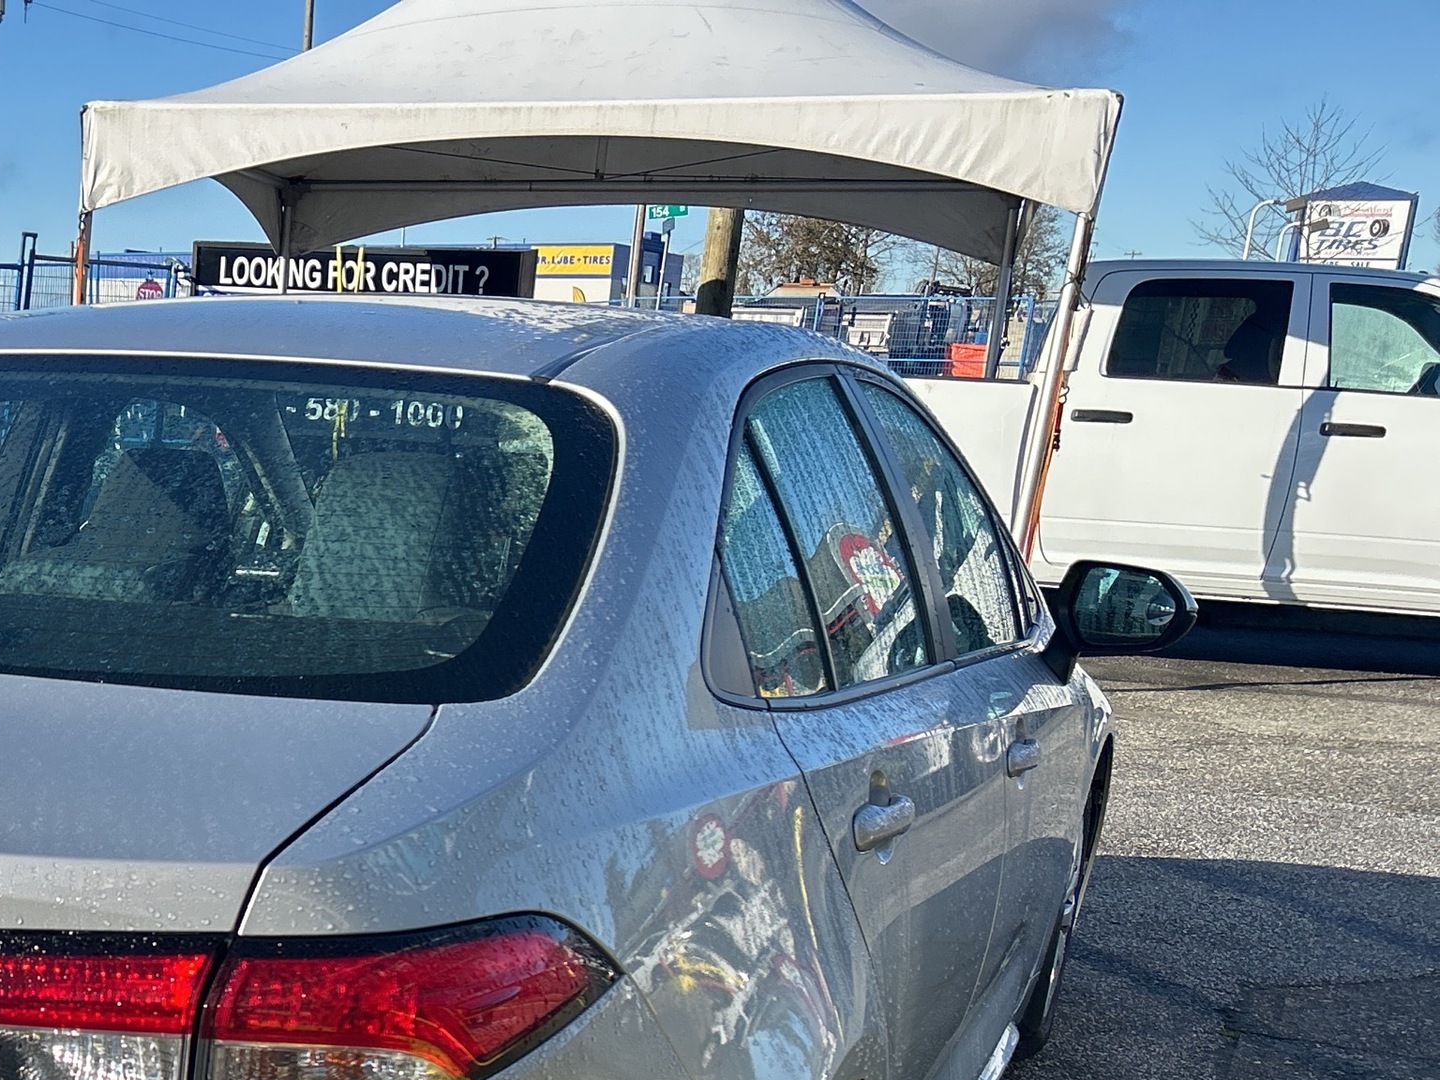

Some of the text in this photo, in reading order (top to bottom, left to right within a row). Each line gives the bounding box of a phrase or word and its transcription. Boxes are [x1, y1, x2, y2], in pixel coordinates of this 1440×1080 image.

[651, 206, 670, 218] 154
[1315, 239, 1379, 251] TIRES
[552, 255, 576, 265] LUBE
[583, 255, 611, 265] TIRES
[219, 256, 490, 294] LOOKNG FOR CREDIT ?
[138, 288, 162, 299] STOP
[390, 399, 464, 429] 1000
